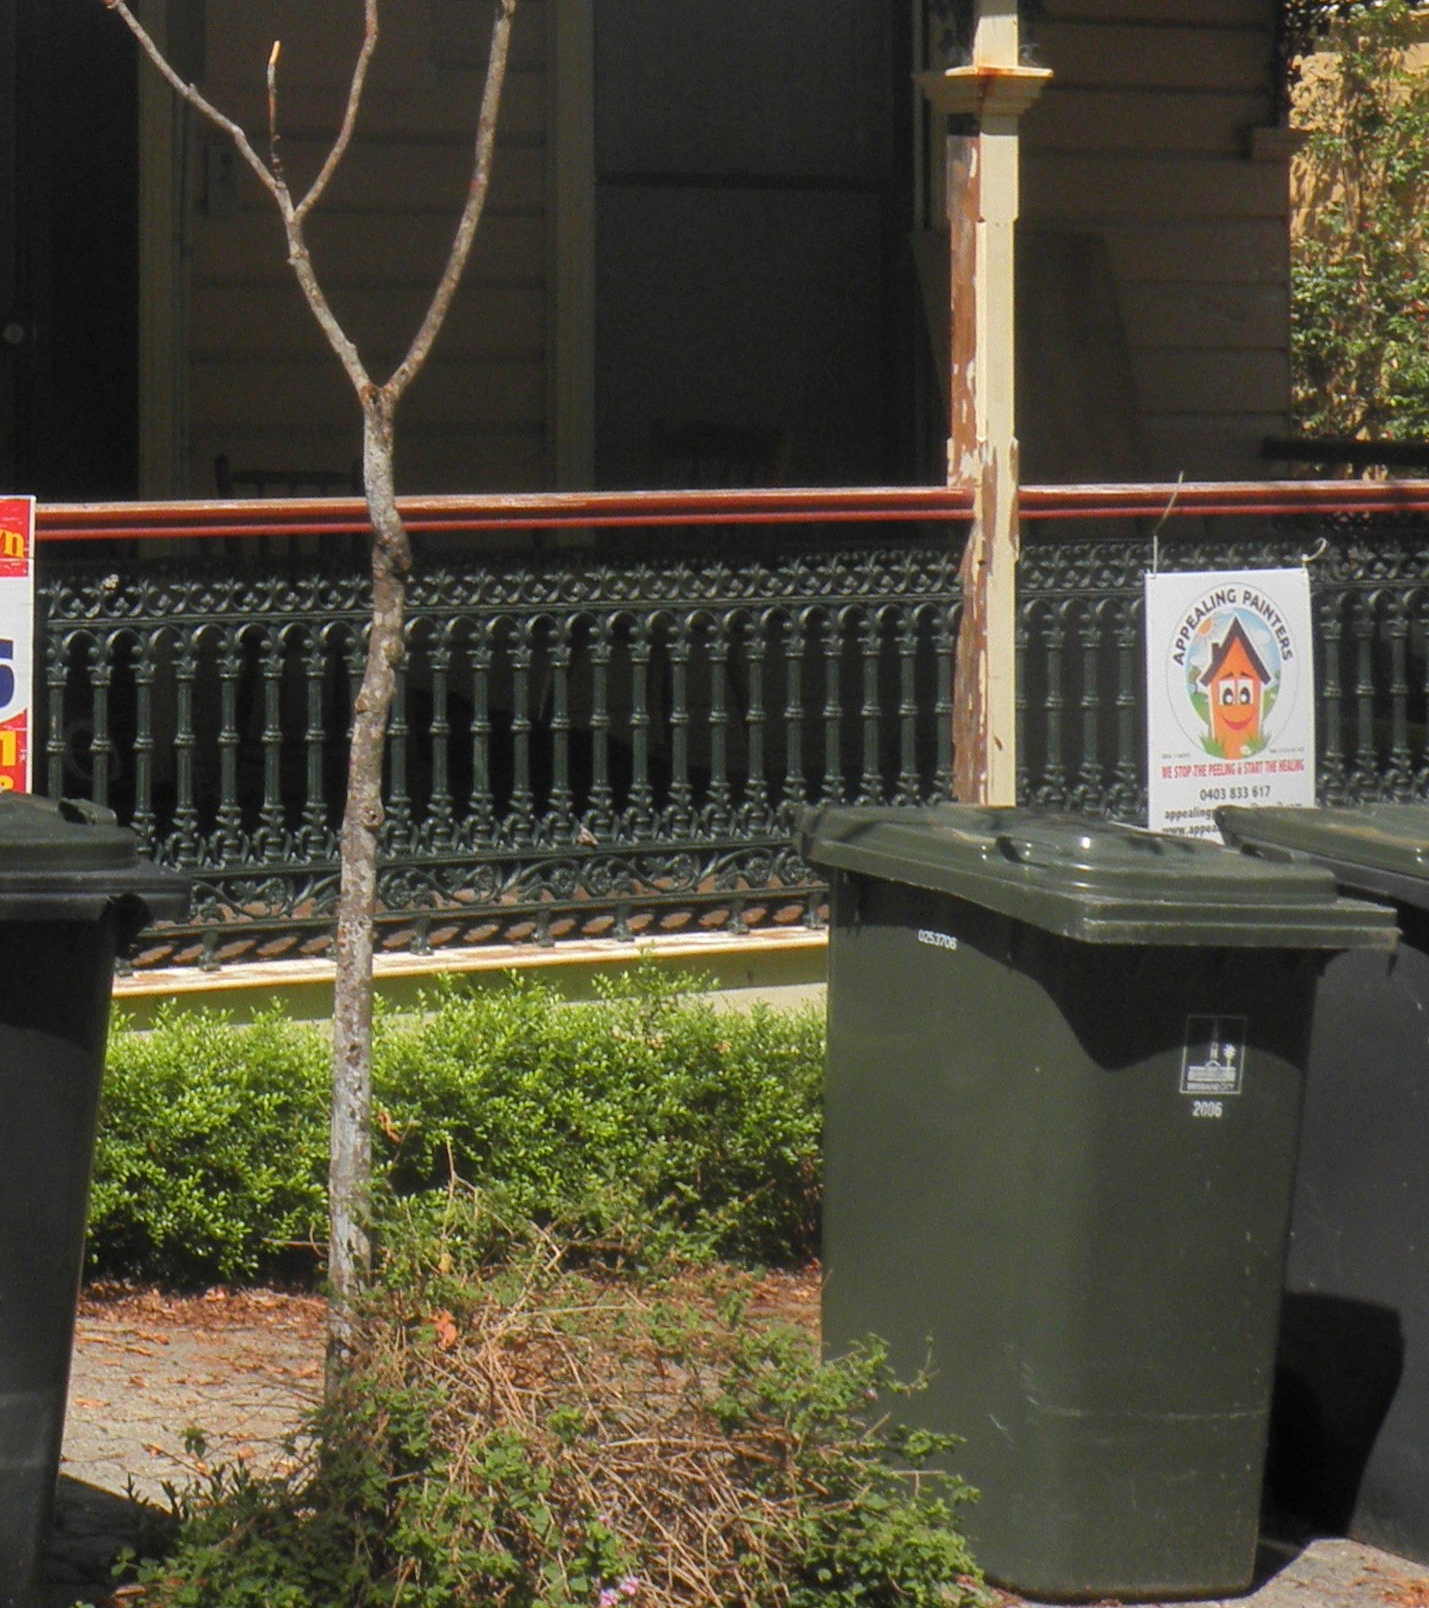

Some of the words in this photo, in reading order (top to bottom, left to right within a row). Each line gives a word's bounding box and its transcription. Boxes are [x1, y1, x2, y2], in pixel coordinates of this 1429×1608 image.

[1172, 588, 1237, 667] APPEALING
[1242, 589, 1294, 661] PAINTERS
[1161, 766, 1172, 779] WE
[1174, 765, 1192, 778] STOP
[1194, 763, 1207, 777] THE
[1208, 762, 1236, 776] PEELING
[1244, 760, 1263, 774] START
[1265, 759, 1277, 773] THE
[1278, 758, 1305, 772] HEALING
[1200, 788, 1226, 801] 0403
[1229, 786, 1249, 799] 833
[1252, 785, 1271, 798] 617
[1193, 1101, 1223, 1118] 2006
